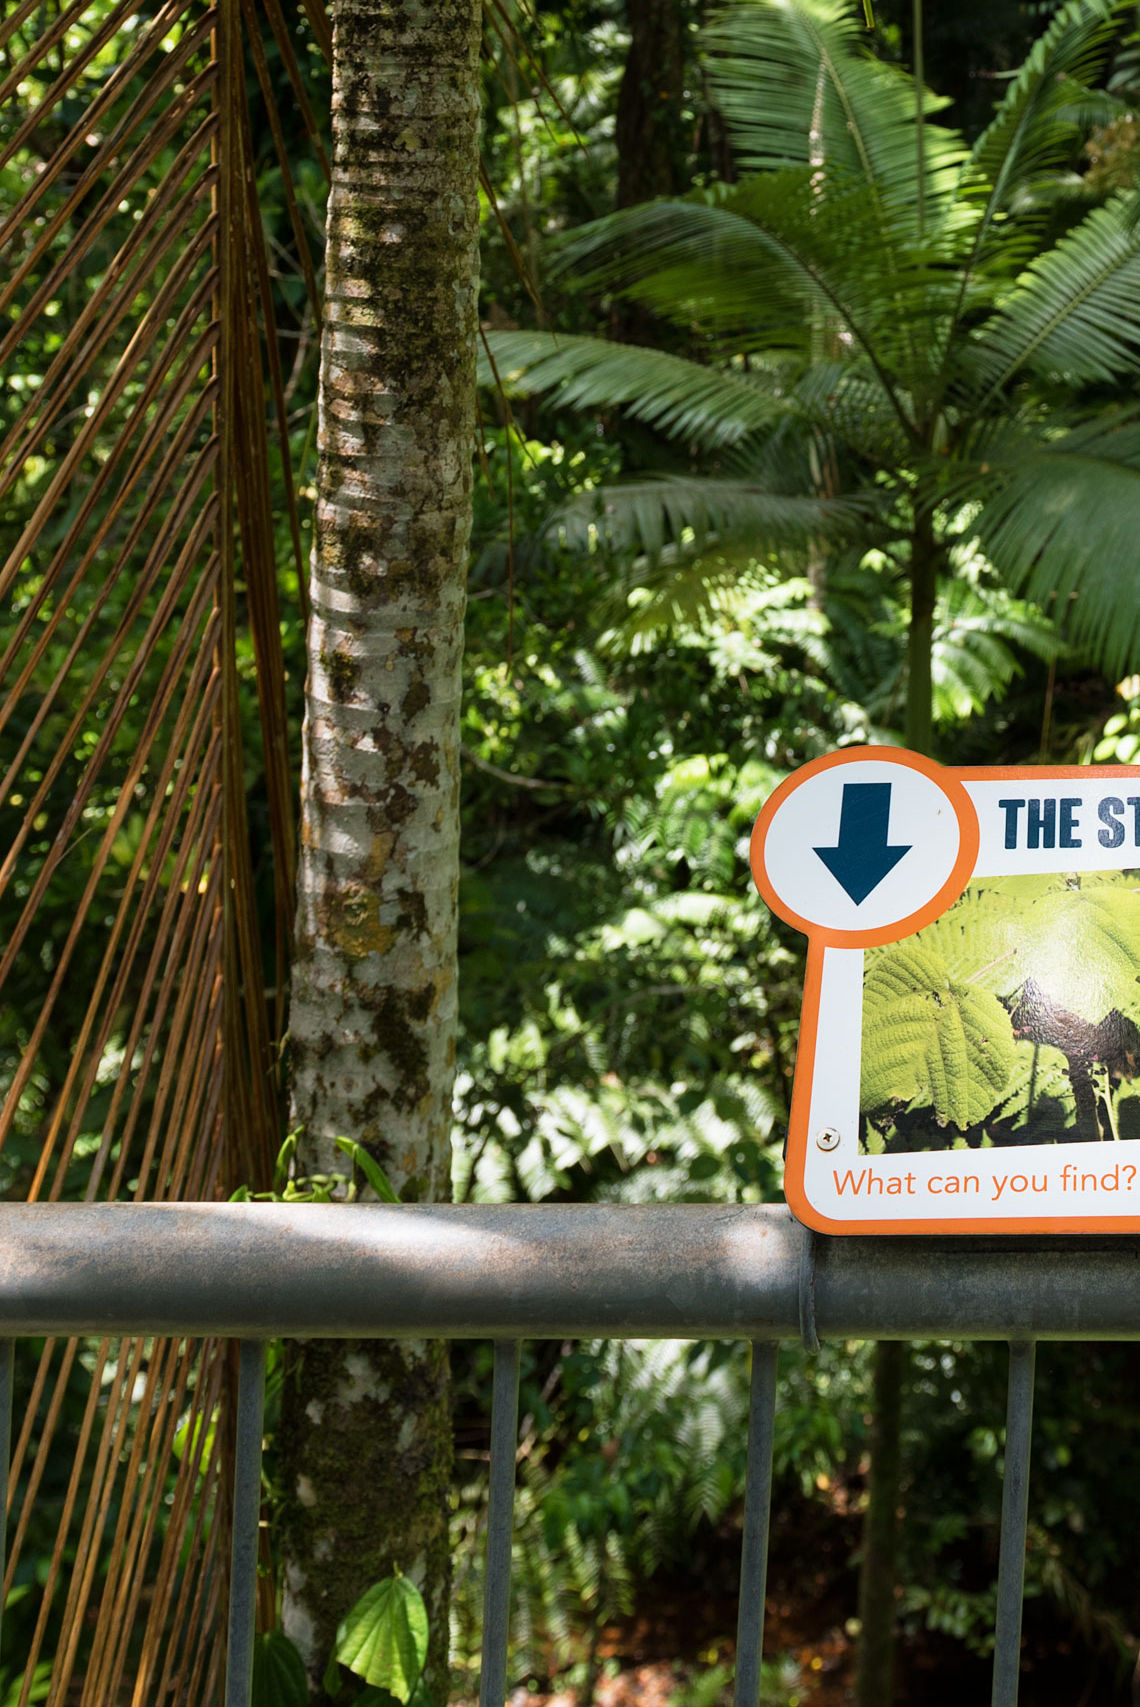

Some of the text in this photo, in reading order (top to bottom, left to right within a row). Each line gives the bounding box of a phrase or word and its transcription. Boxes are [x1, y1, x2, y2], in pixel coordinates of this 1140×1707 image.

[998, 797, 1083, 850] THE
[833, 1168, 916, 1196] What
[927, 1175, 979, 1194] can
[991, 1175, 1047, 1201] you
[1059, 1164, 1137, 1192] find?
